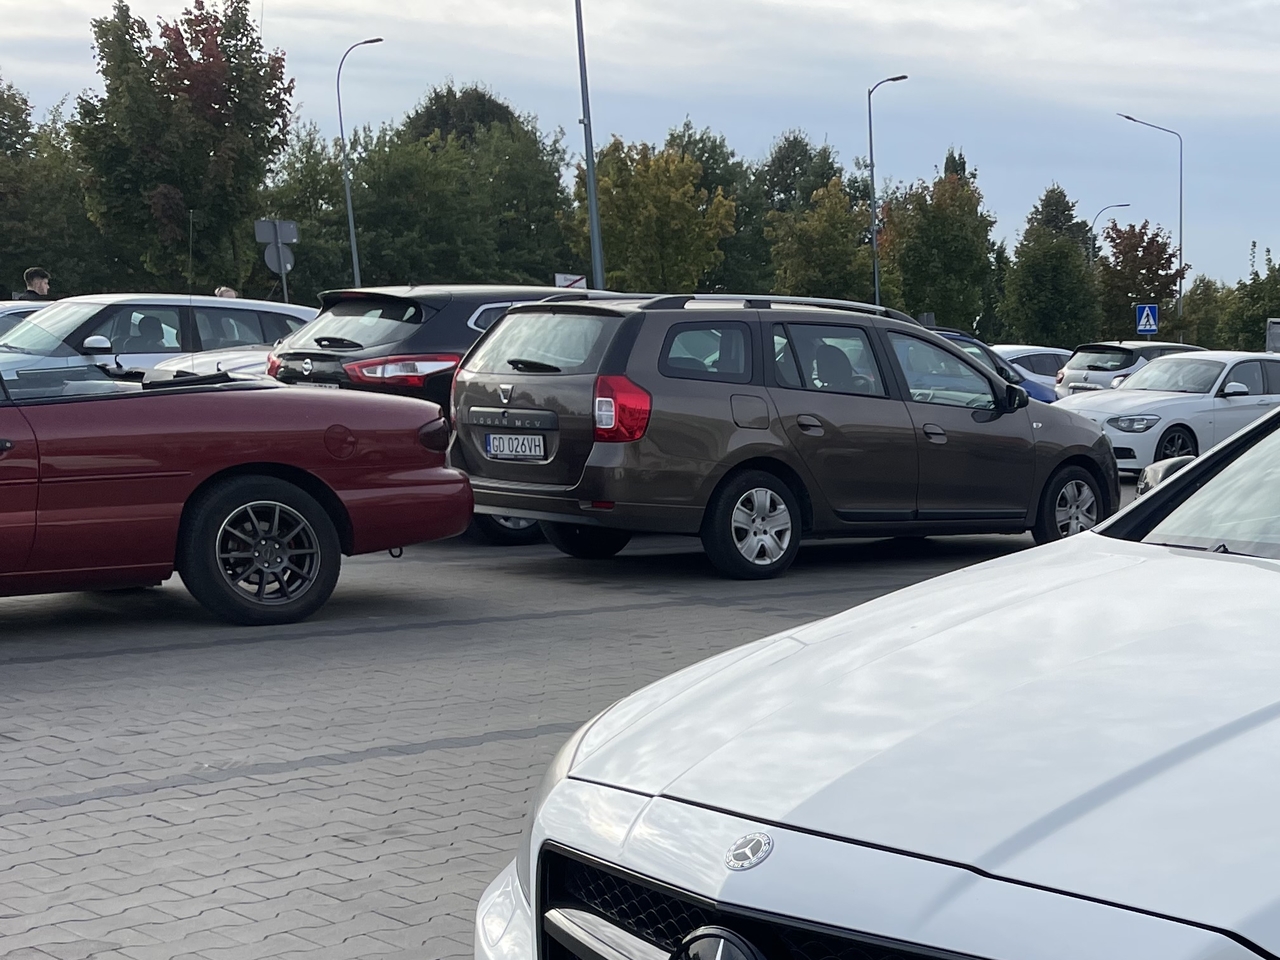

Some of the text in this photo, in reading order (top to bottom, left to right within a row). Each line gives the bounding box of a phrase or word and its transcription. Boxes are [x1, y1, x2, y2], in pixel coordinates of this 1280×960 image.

[473, 417, 508, 425] LOGAN
[492, 437, 542, 454] GD 026VH
